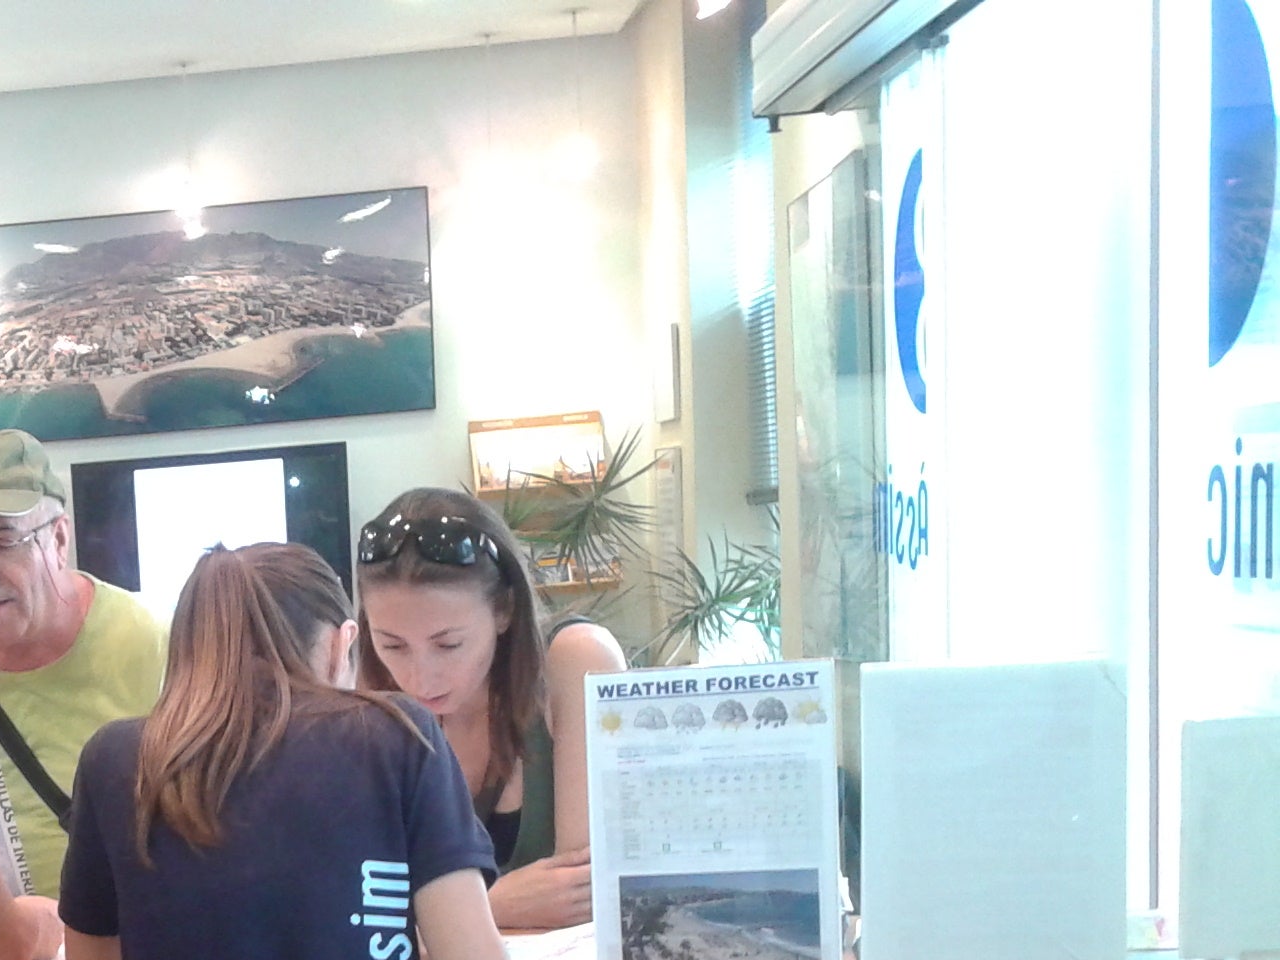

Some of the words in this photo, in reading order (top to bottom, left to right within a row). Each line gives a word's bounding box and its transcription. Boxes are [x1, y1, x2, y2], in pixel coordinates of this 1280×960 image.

[596, 677, 699, 699] WEATHER
[705, 671, 820, 693] FORECAST
[7, 825, 19, 844] DE
[13, 847, 37, 896] INTERI
